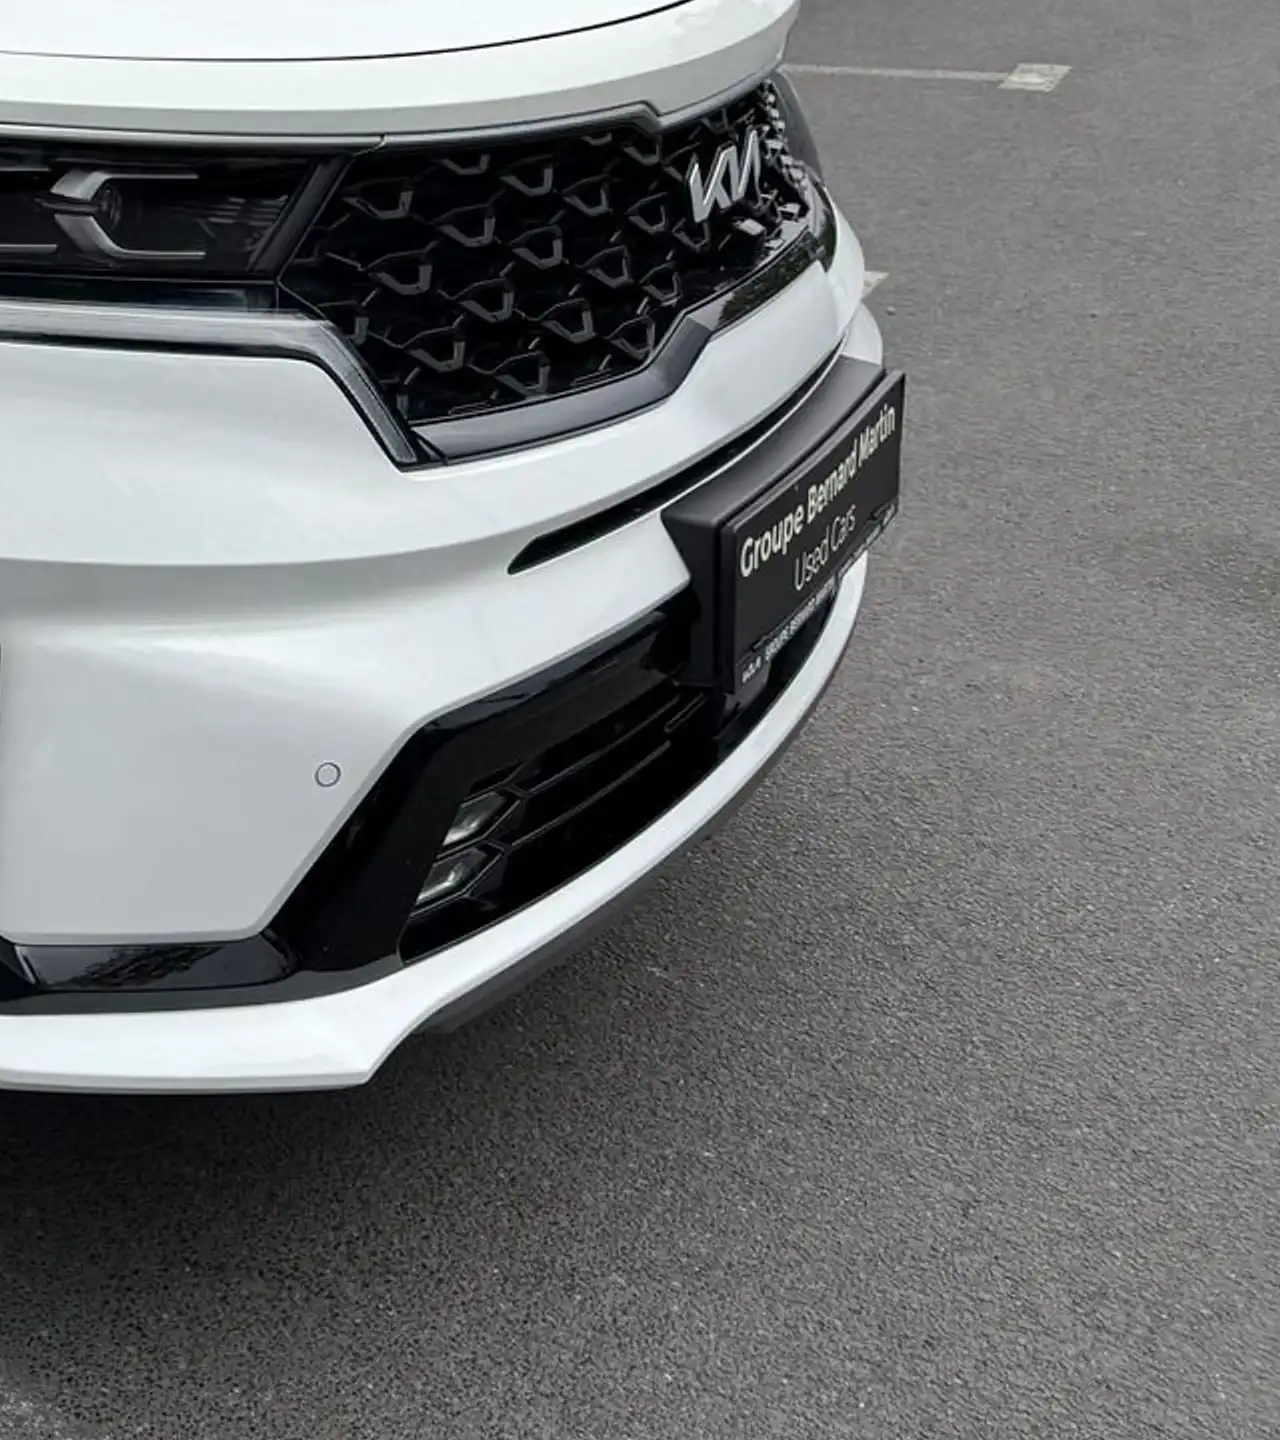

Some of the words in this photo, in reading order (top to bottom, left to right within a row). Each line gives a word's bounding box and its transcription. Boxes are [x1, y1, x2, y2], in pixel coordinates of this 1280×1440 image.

[688, 128, 761, 223] KIA
[740, 505, 805, 578] Groupe
[806, 438, 857, 525] Bernard
[856, 402, 897, 468] Martin
[793, 524, 830, 591] Used
[829, 503, 857, 552] Cars
